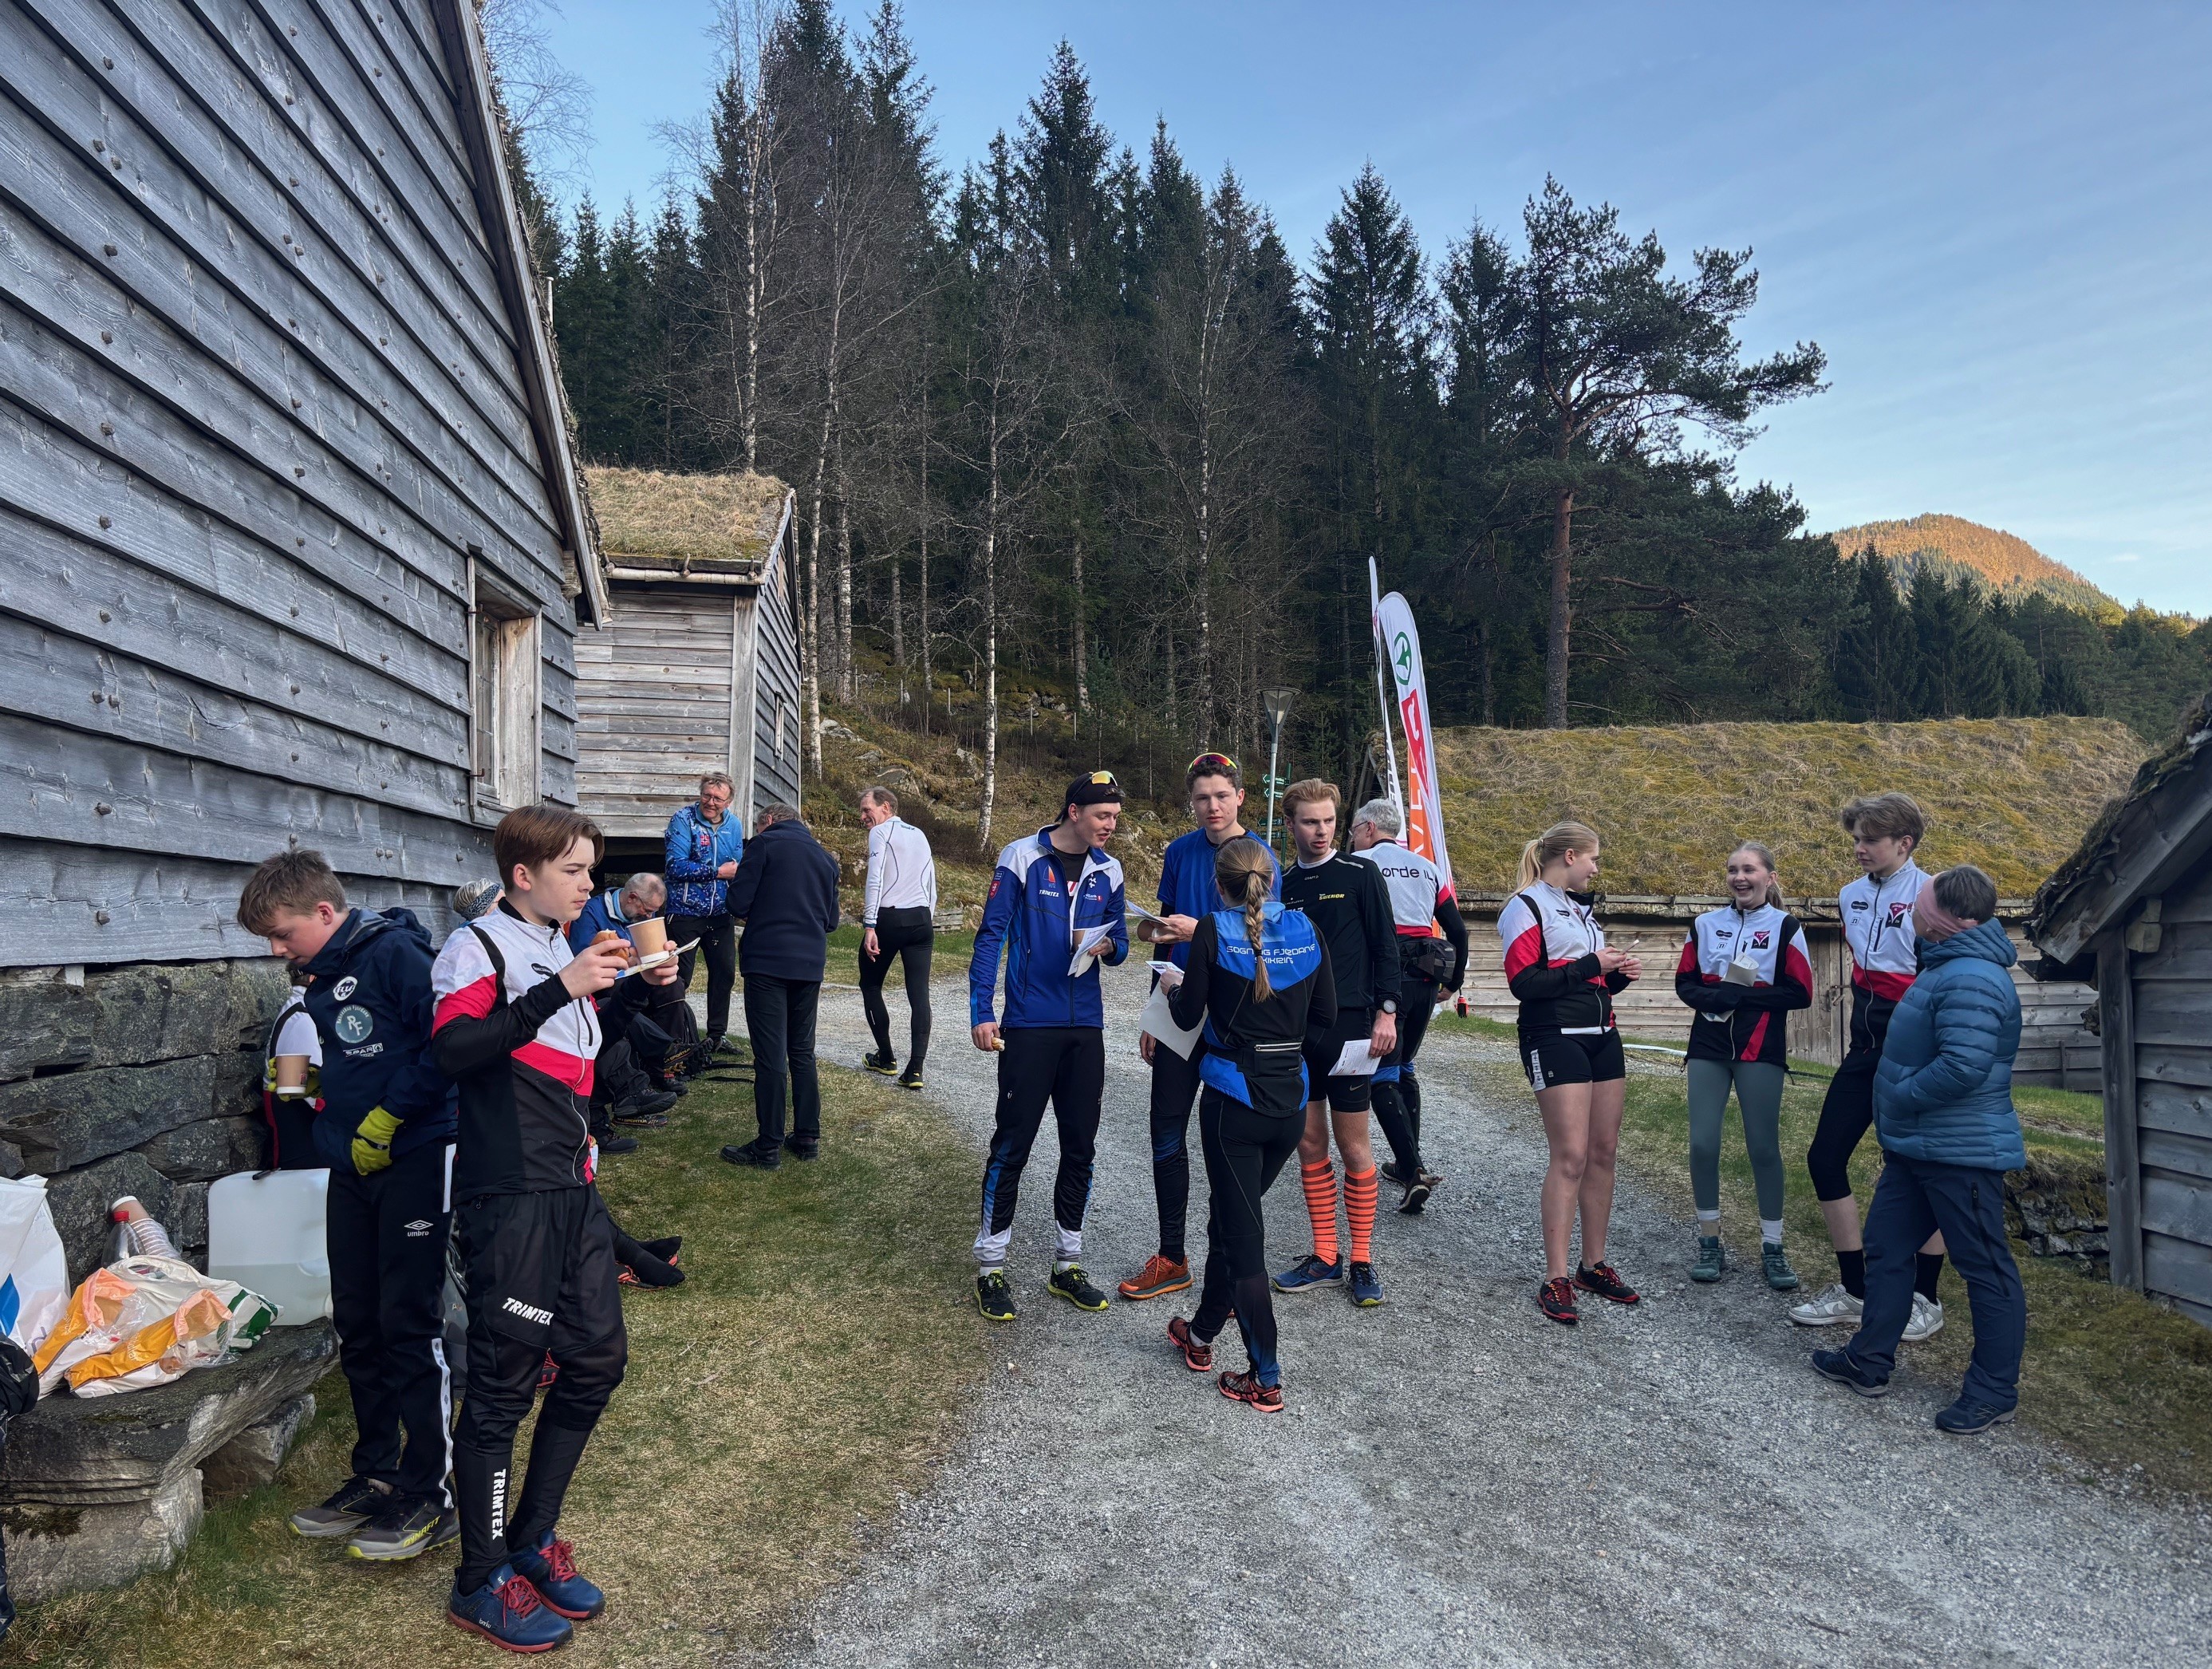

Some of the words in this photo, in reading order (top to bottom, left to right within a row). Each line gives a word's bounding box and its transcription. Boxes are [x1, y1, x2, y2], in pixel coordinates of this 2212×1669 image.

[1382, 866, 1420, 878] ørde
[1039, 889, 1059, 898] TRIMTEX
[1226, 945, 1255, 955] SOGN
[502, 1296, 554, 1326] TRIMTEX
[492, 1468, 507, 1541] TRIMTEX
[402, 1515, 441, 1548] DYNAFIT
